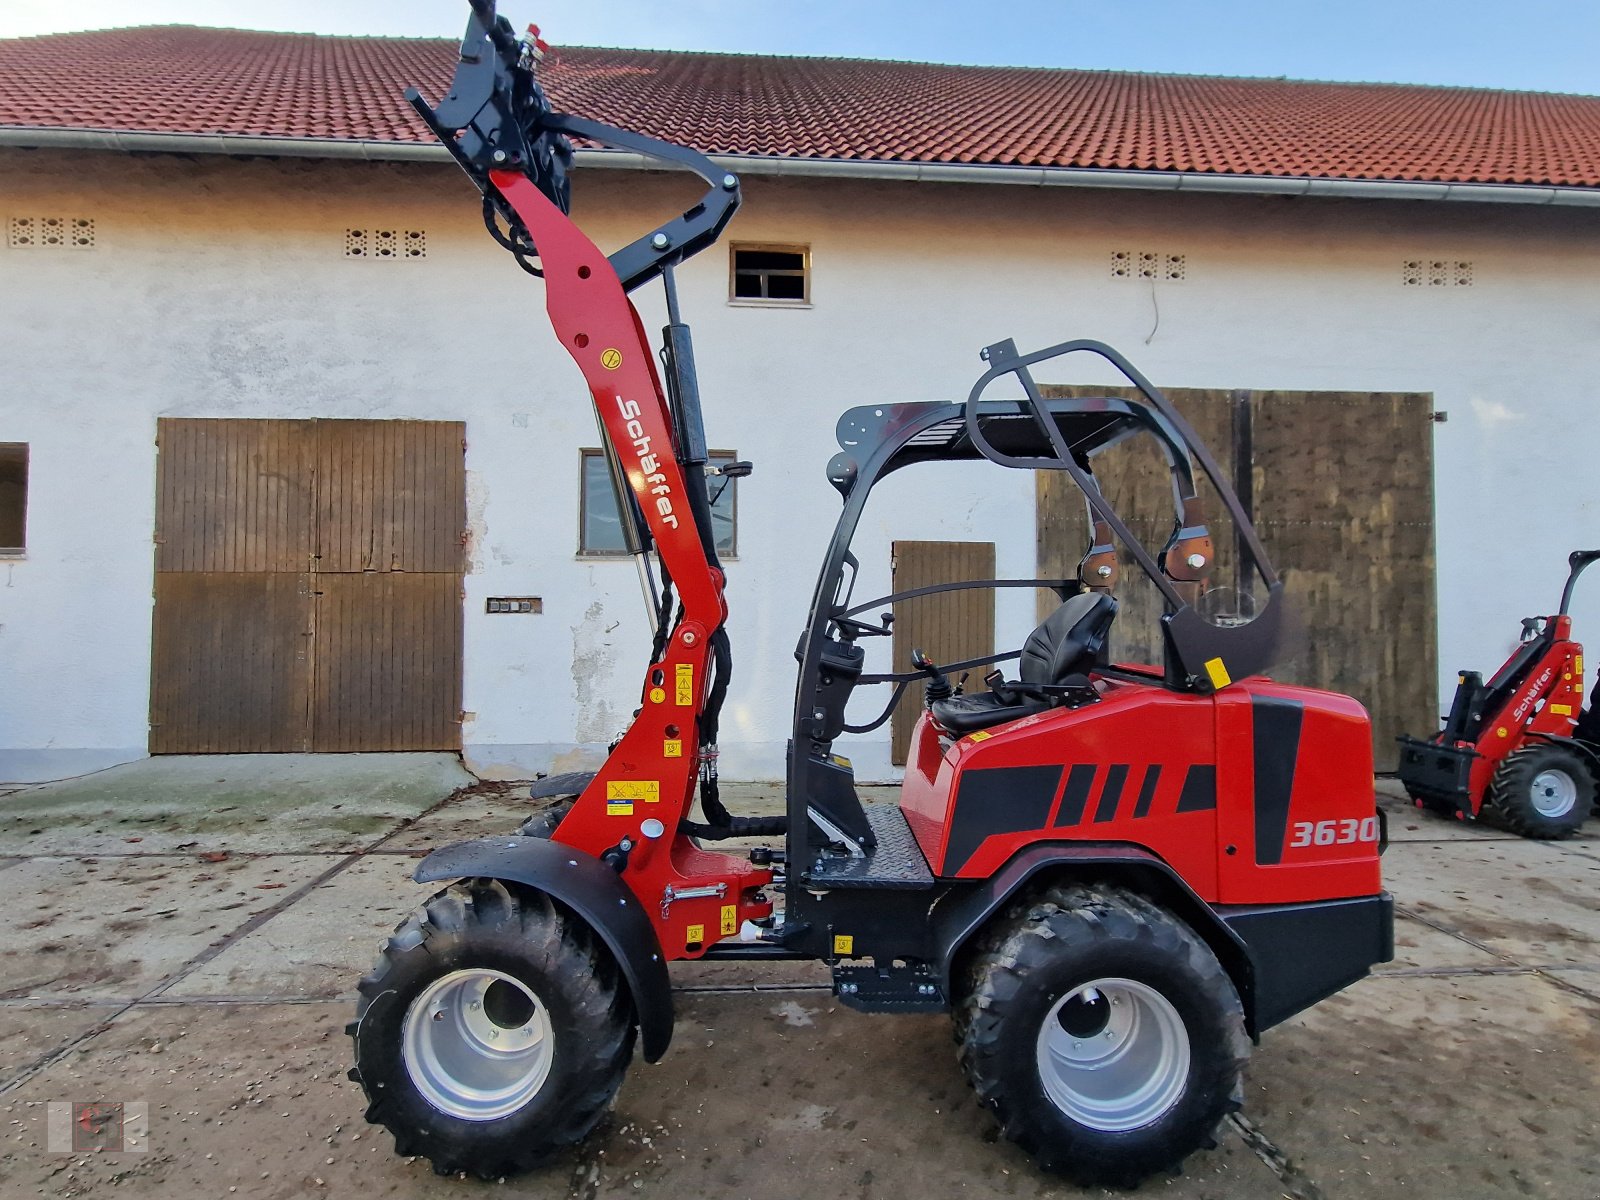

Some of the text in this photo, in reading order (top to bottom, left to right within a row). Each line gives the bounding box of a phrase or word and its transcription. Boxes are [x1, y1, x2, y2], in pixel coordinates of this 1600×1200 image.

[615, 395, 680, 530] Schäffer
[1513, 667, 1552, 722] Schäffer
[1290, 816, 1380, 848] 3630
